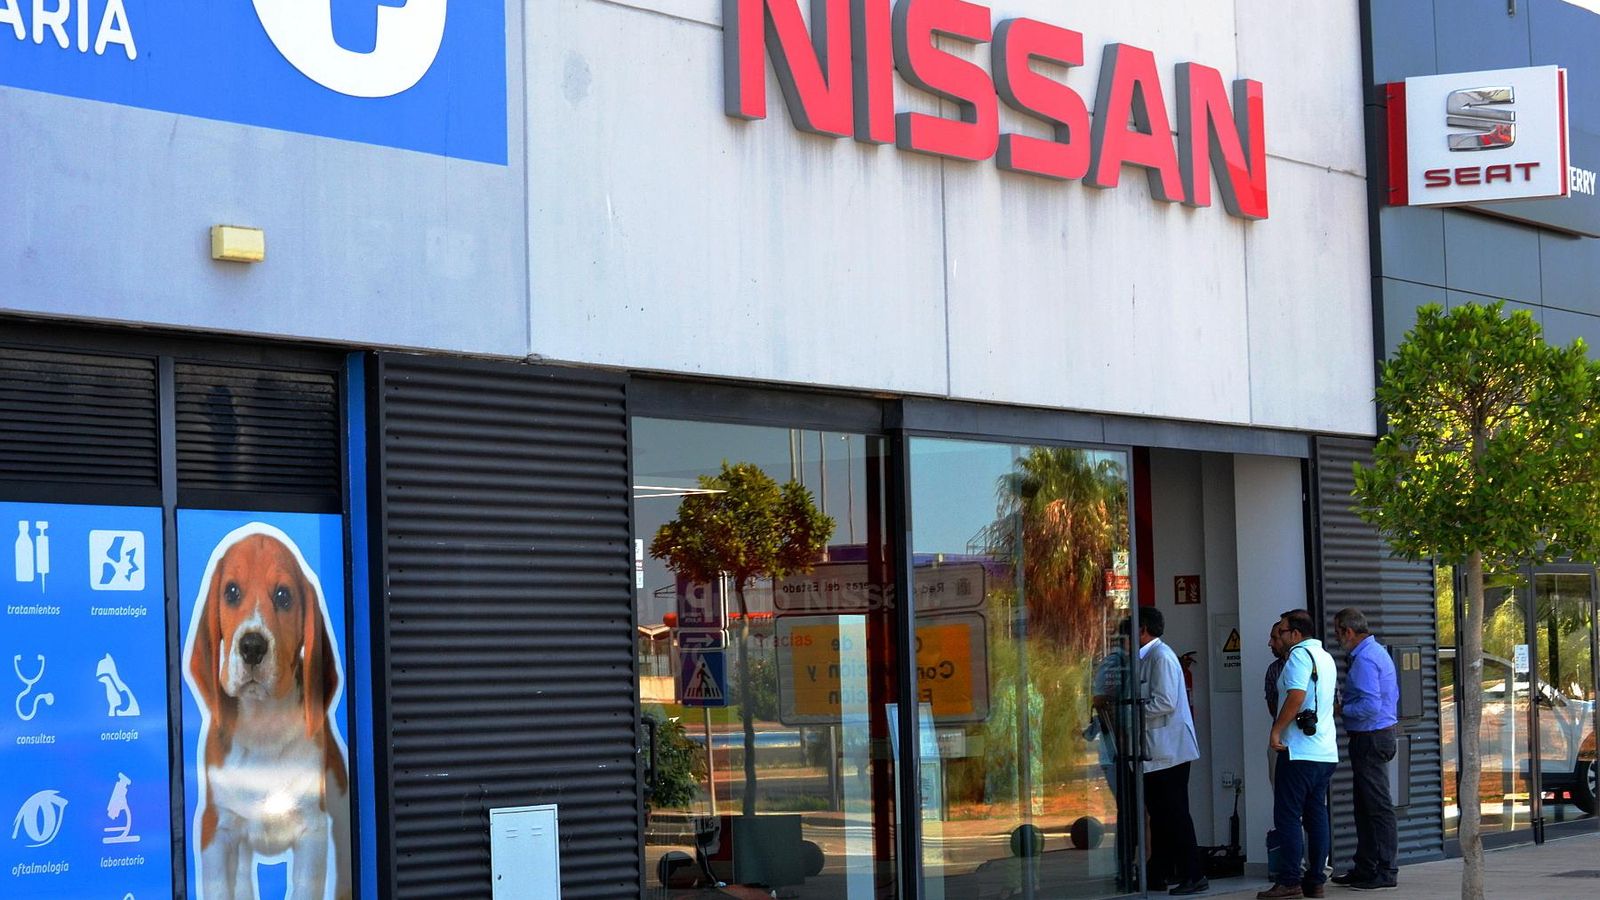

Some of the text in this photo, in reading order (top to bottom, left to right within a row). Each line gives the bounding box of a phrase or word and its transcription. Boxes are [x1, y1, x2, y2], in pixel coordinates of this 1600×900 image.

[723, 0, 1268, 220] NISSAN
[1424, 162, 1541, 188] SEAT
[1570, 166, 1597, 195] ERRY
[7, 604, 61, 615] tratamientos
[16, 733, 56, 745] consultas
[100, 855, 145, 868] laboratorio
